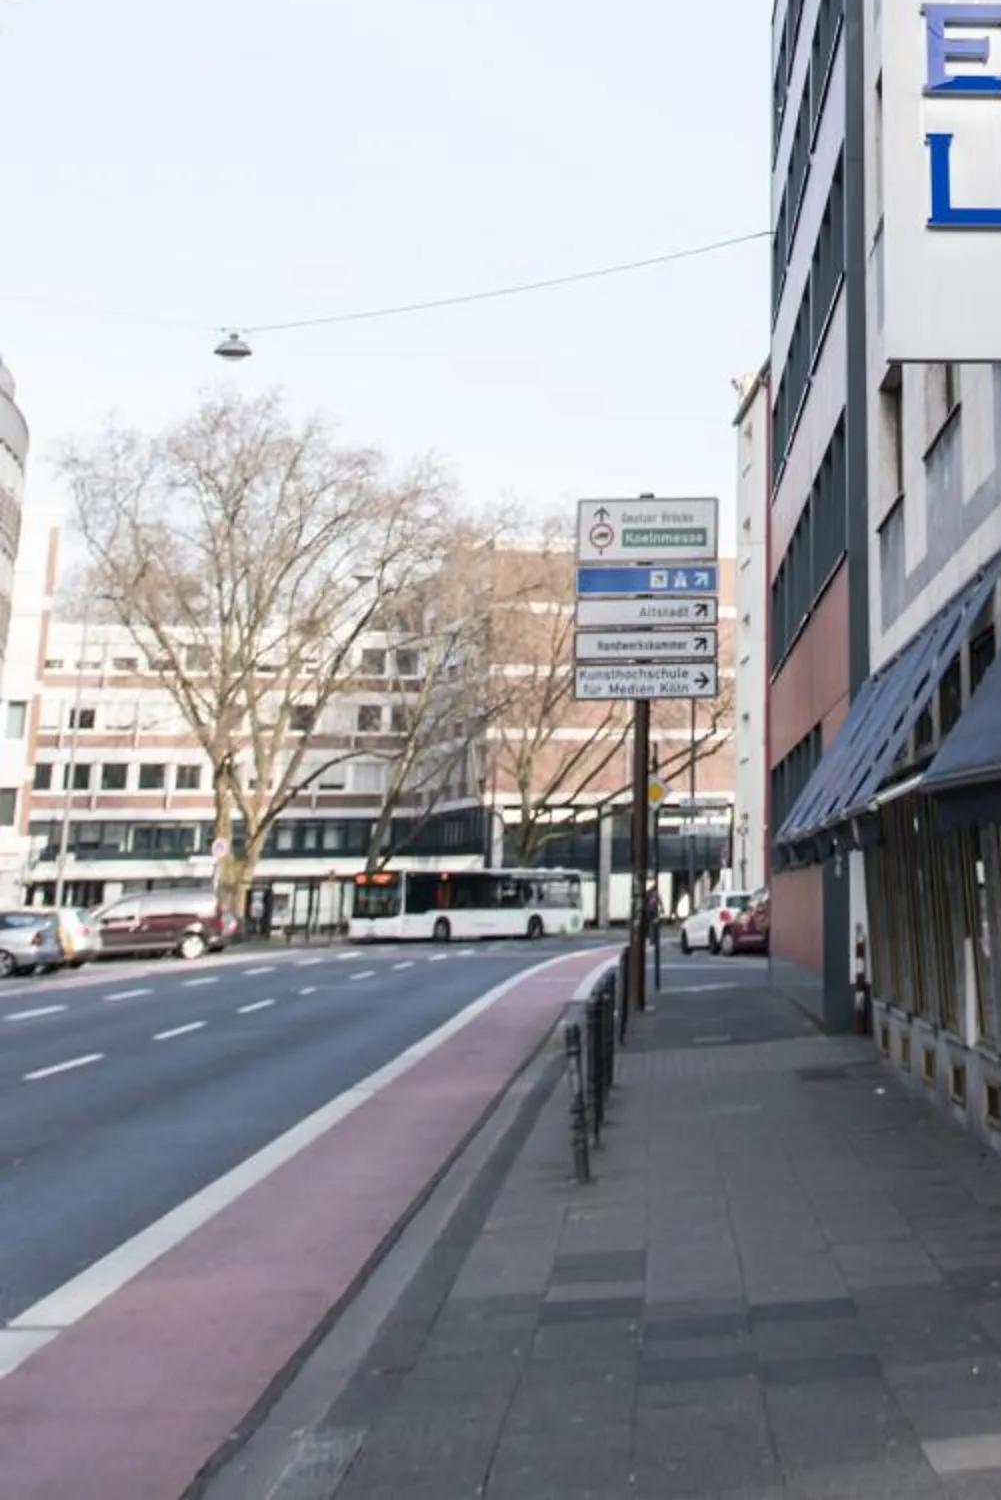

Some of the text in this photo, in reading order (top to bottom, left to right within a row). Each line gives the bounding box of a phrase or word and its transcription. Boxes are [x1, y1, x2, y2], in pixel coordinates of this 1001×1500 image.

[624, 531, 702, 544] Koelnmesse
[639, 605, 689, 618] Altstadt
[579, 668, 689, 681] Kunsthochschule
[608, 683, 655, 695] Medien
[659, 682, 689, 694] Köln
